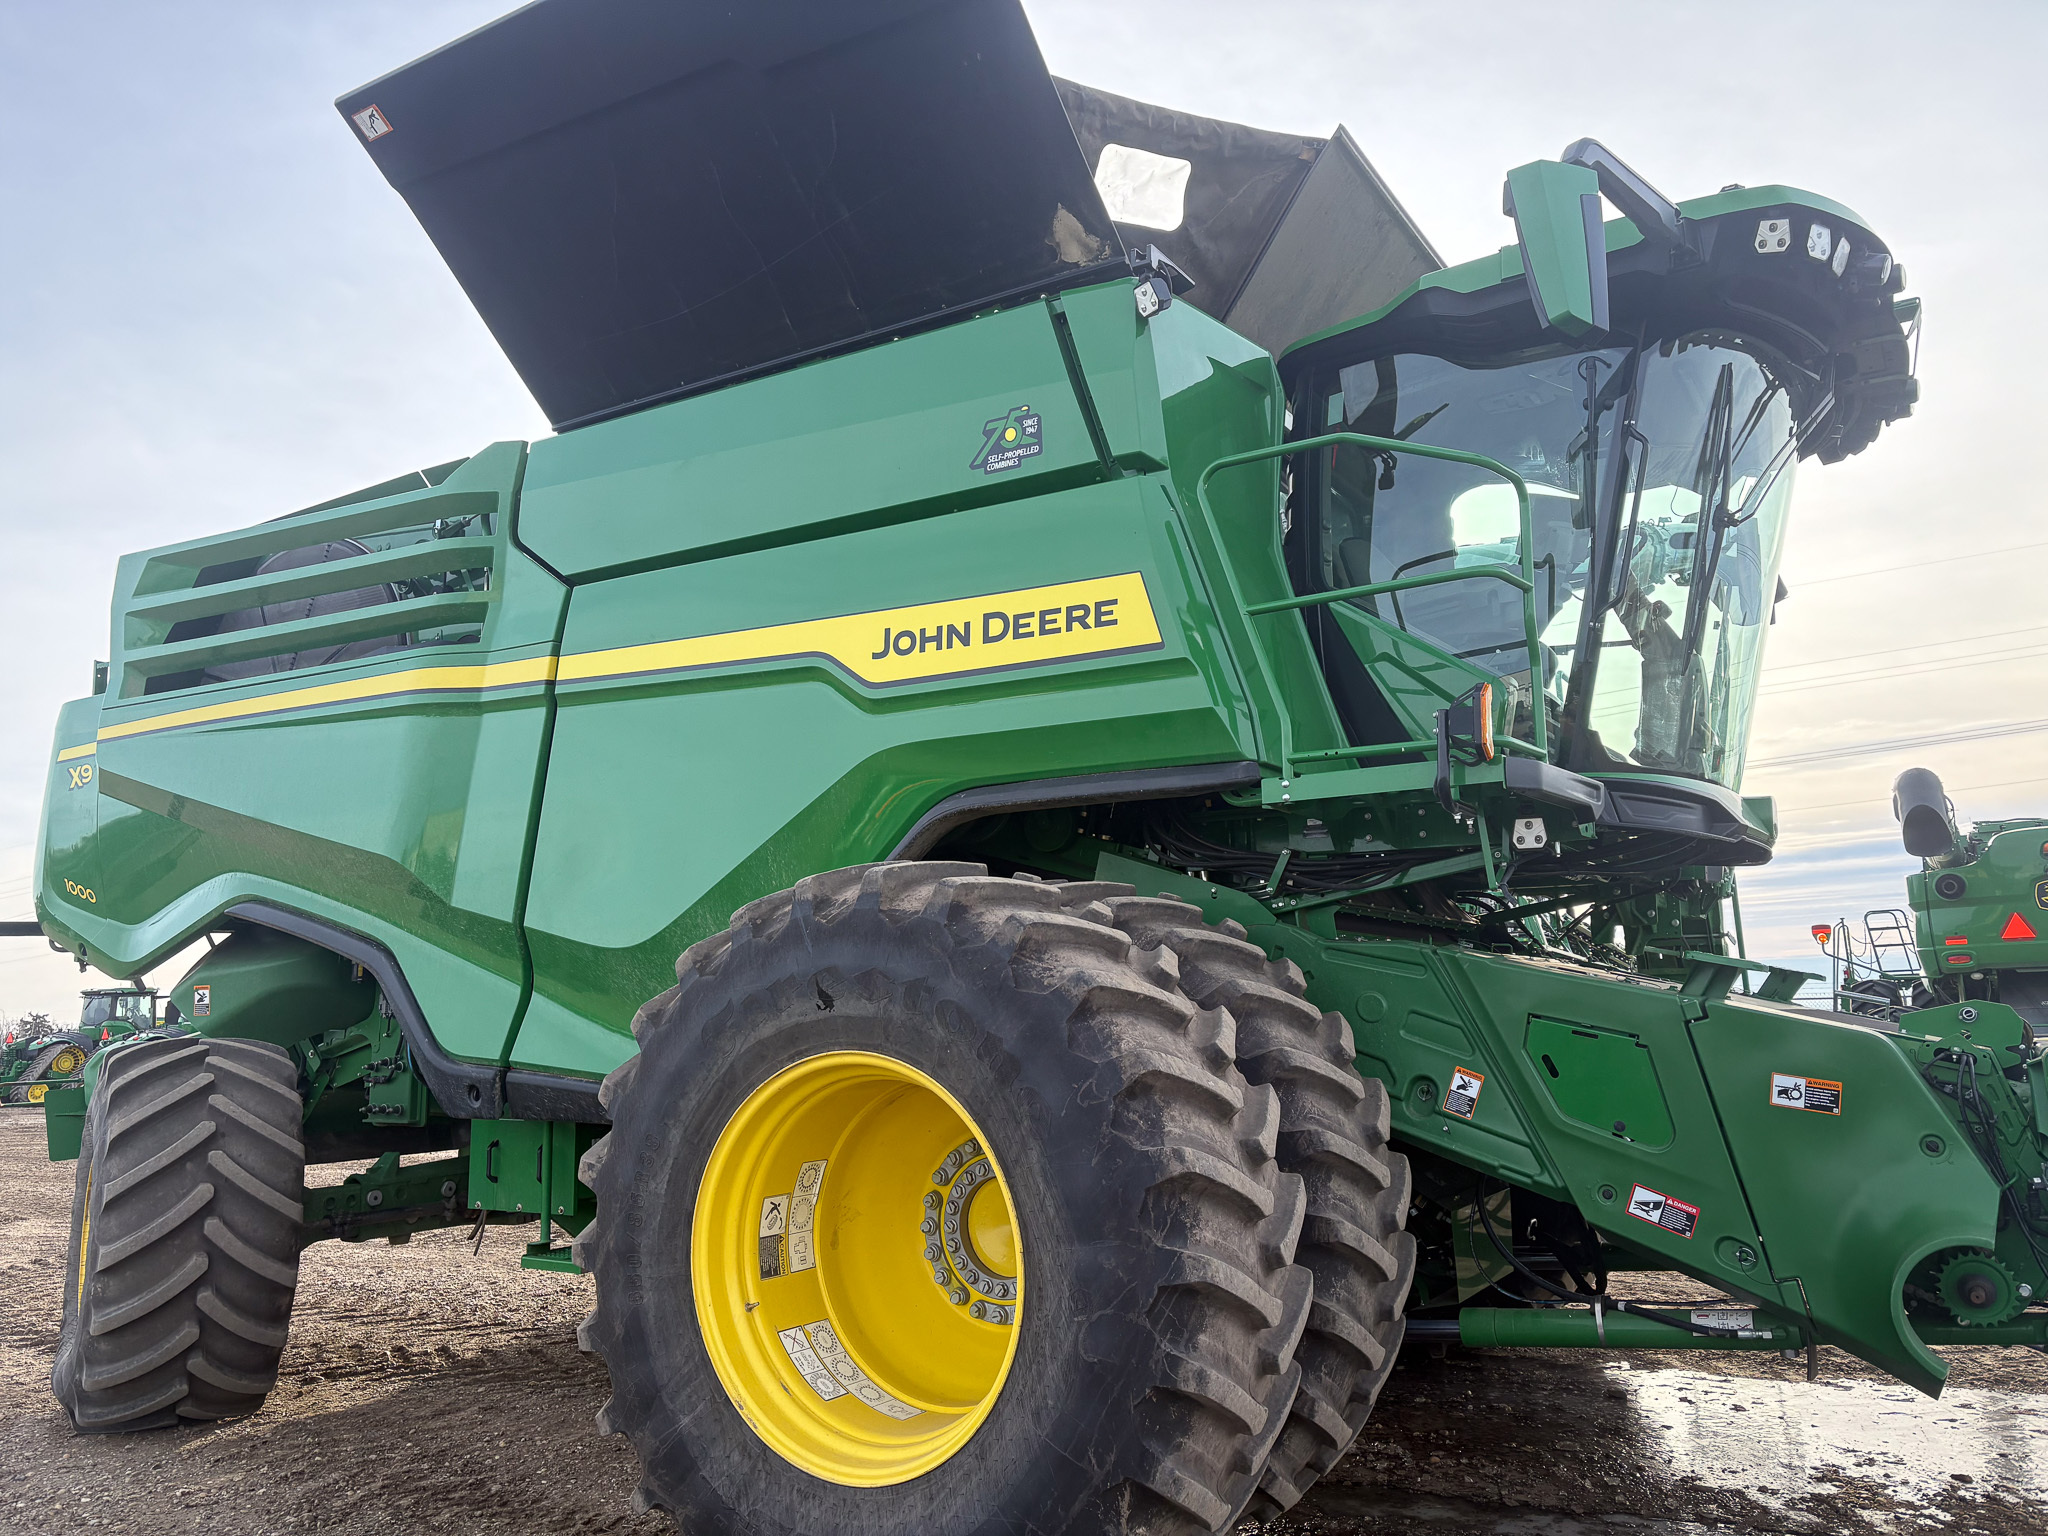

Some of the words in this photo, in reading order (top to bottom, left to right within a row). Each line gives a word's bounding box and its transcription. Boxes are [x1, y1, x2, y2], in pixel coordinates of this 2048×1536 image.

[1022, 417, 1039, 428] SINCE
[1025, 426, 1038, 435] 1947
[987, 445, 1039, 463] SELF-PROPELLED
[986, 458, 1018, 472] COMBINES
[872, 621, 971, 660] JOHN
[982, 598, 1119, 644] DEERE
[68, 764, 93, 791] X9
[63, 877, 97, 904] 1000
[1462, 1069, 1482, 1081] WARNING
[1812, 1080, 1840, 1089] WARNING
[1673, 1201, 1698, 1214] DANGER
[779, 1243, 787, 1275] CAUTION
